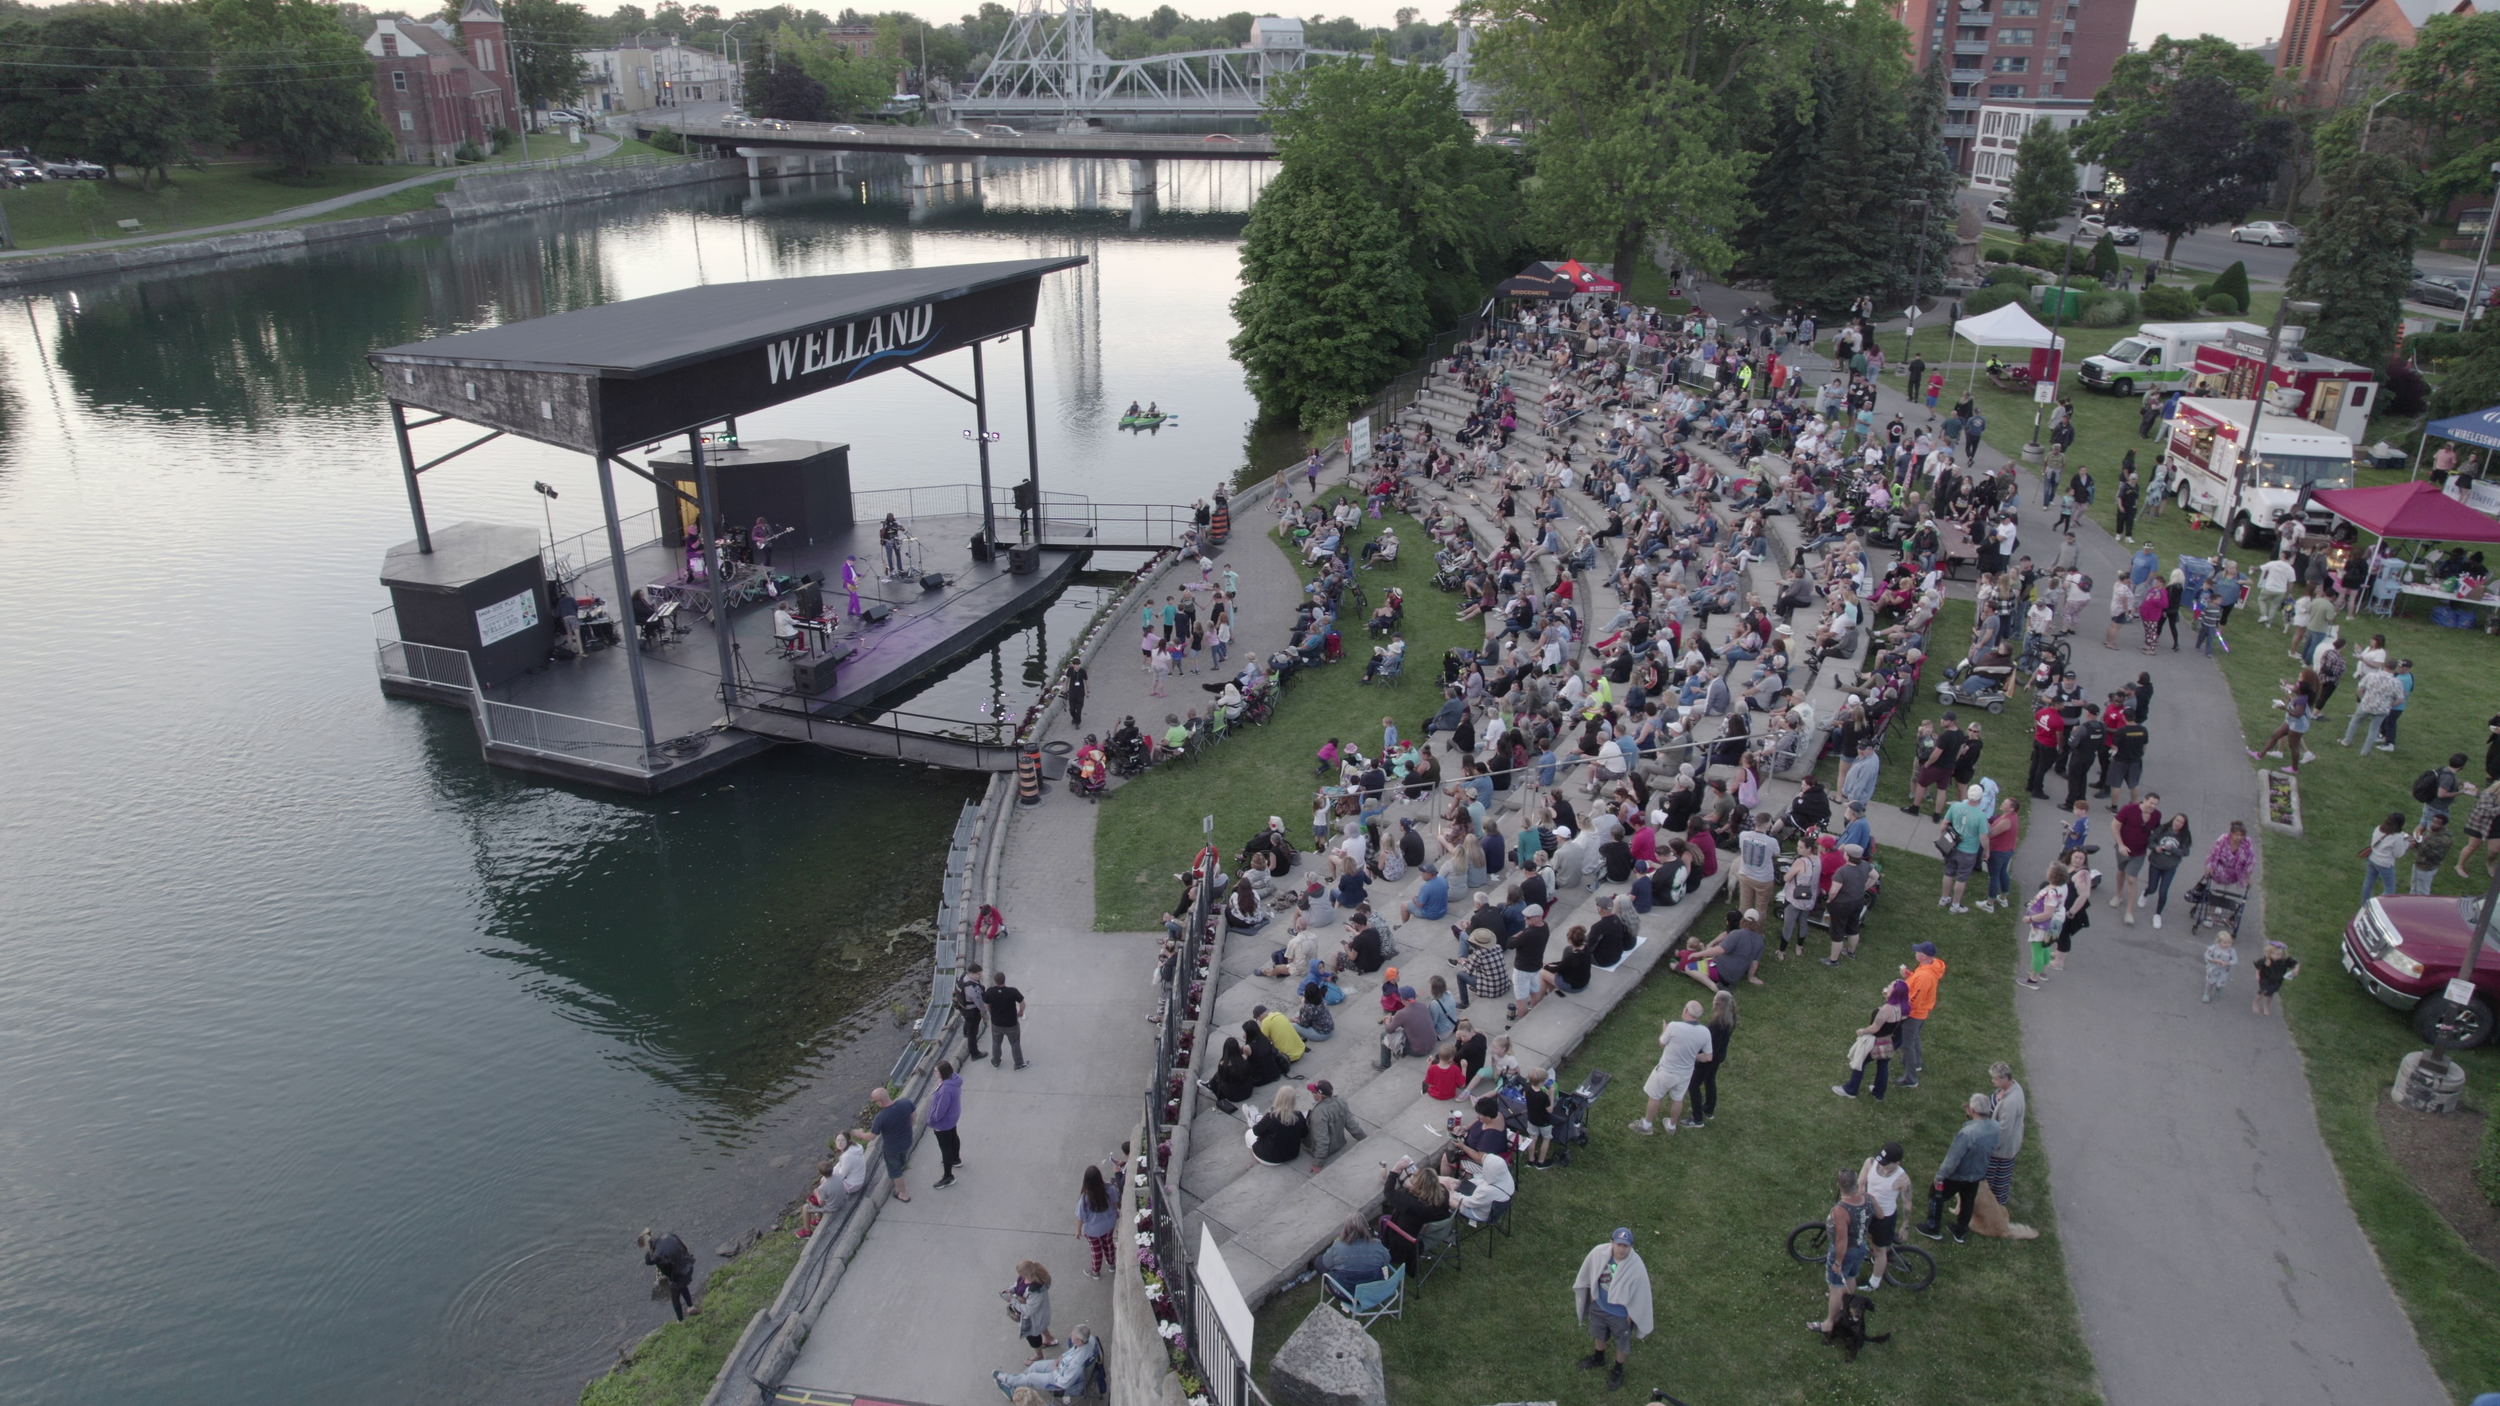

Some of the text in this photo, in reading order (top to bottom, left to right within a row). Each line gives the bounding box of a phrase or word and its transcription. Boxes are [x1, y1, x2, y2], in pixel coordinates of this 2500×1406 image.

[767, 303, 933, 385] WELLAND
[2236, 342, 2265, 356] PATTIES
[1354, 443, 1367, 453] Free
[482, 617, 519, 636] WELLAND
